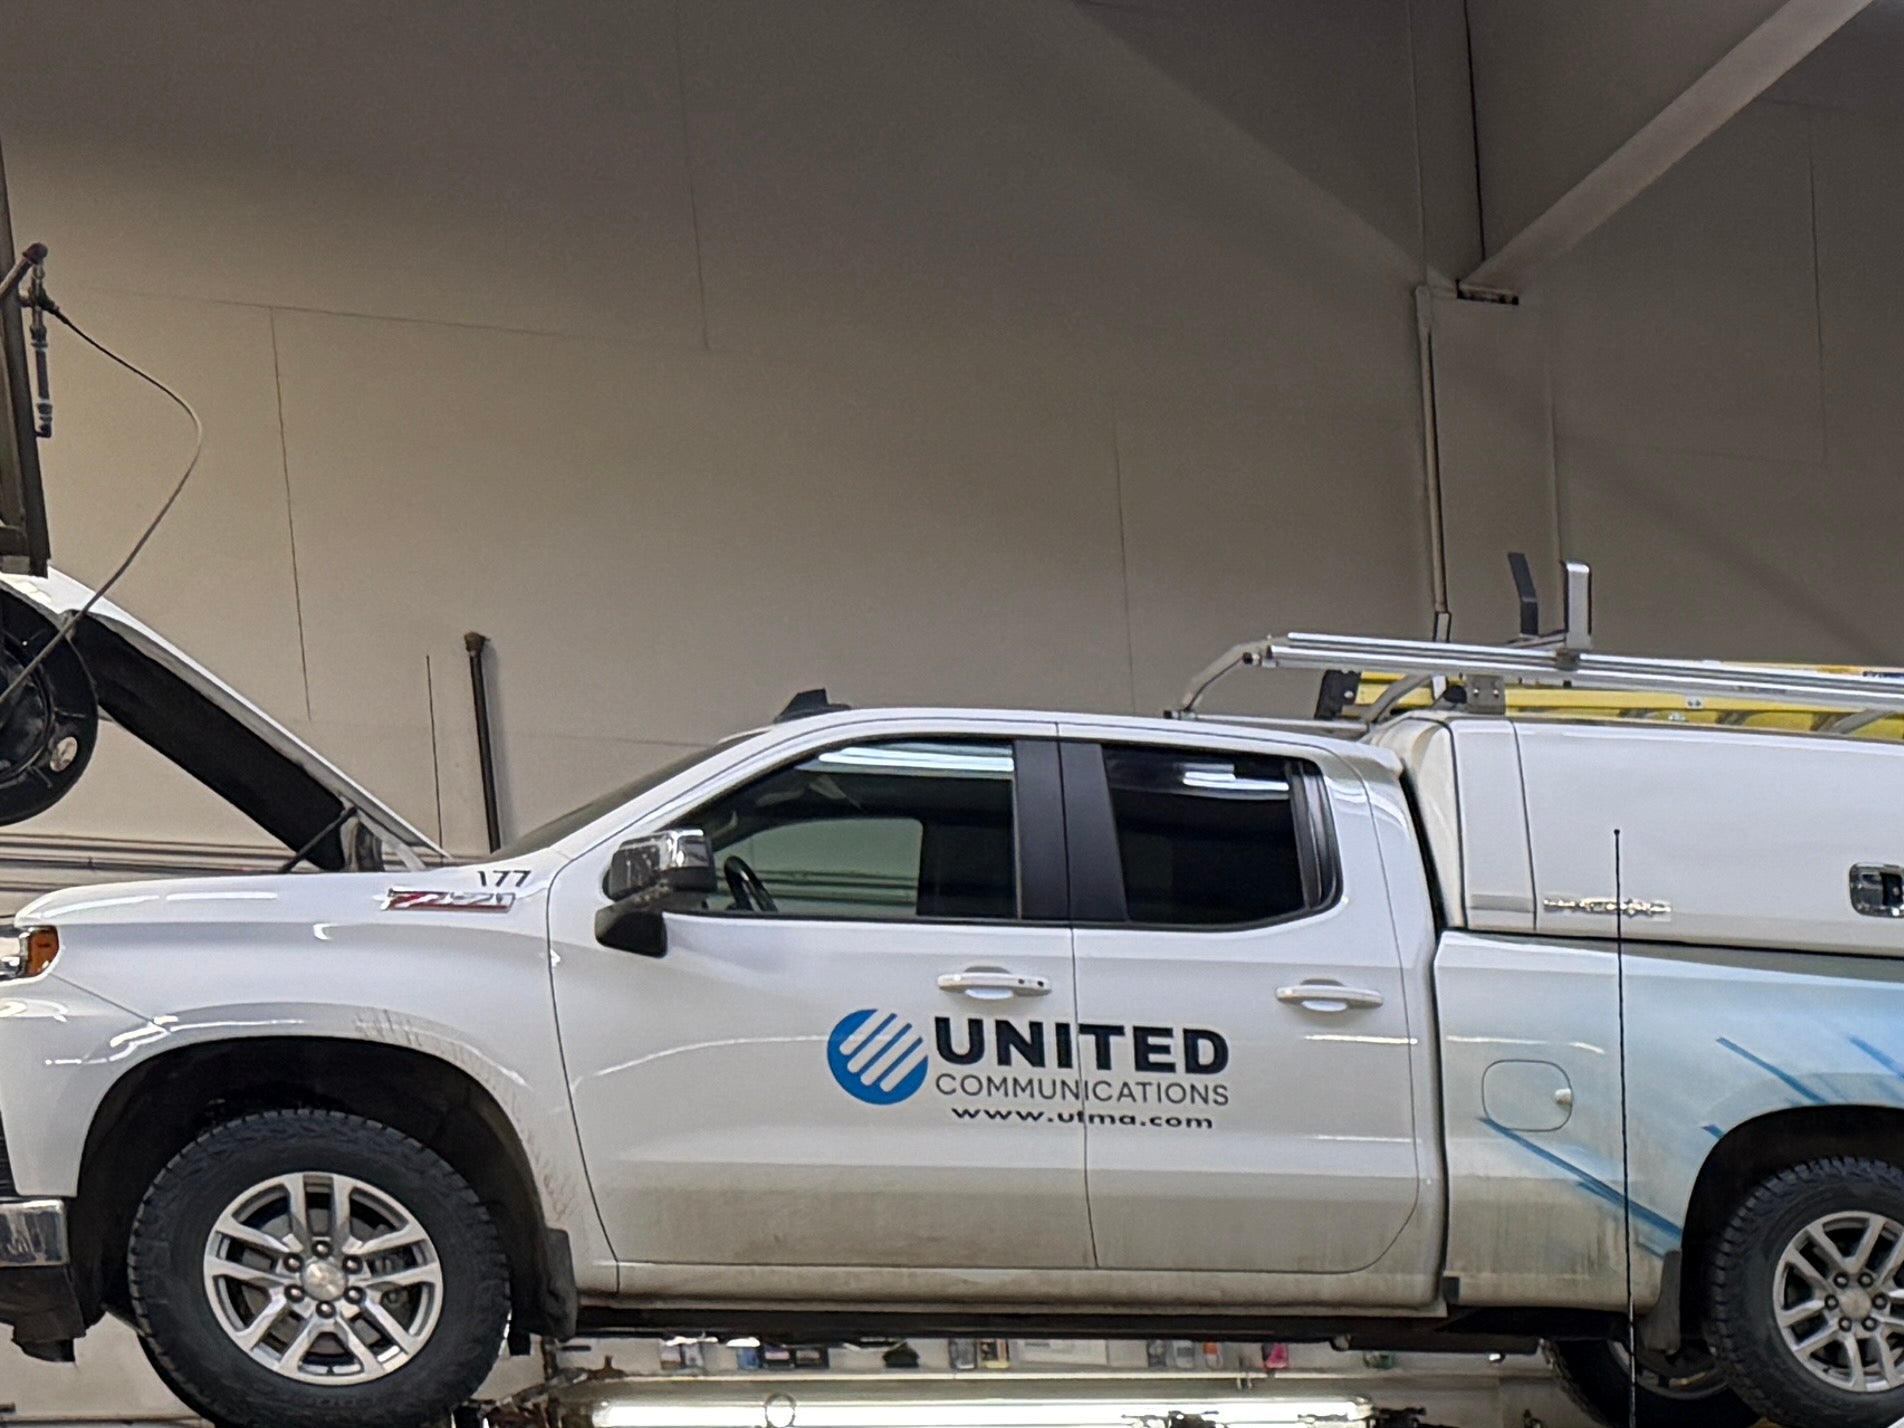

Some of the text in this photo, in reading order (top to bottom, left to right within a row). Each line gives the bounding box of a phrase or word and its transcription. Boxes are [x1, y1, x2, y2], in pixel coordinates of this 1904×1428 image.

[477, 869, 532, 888] 177
[934, 1015, 1230, 1075] UNITED
[935, 1073, 1230, 1106] COMMUNICATIONS
